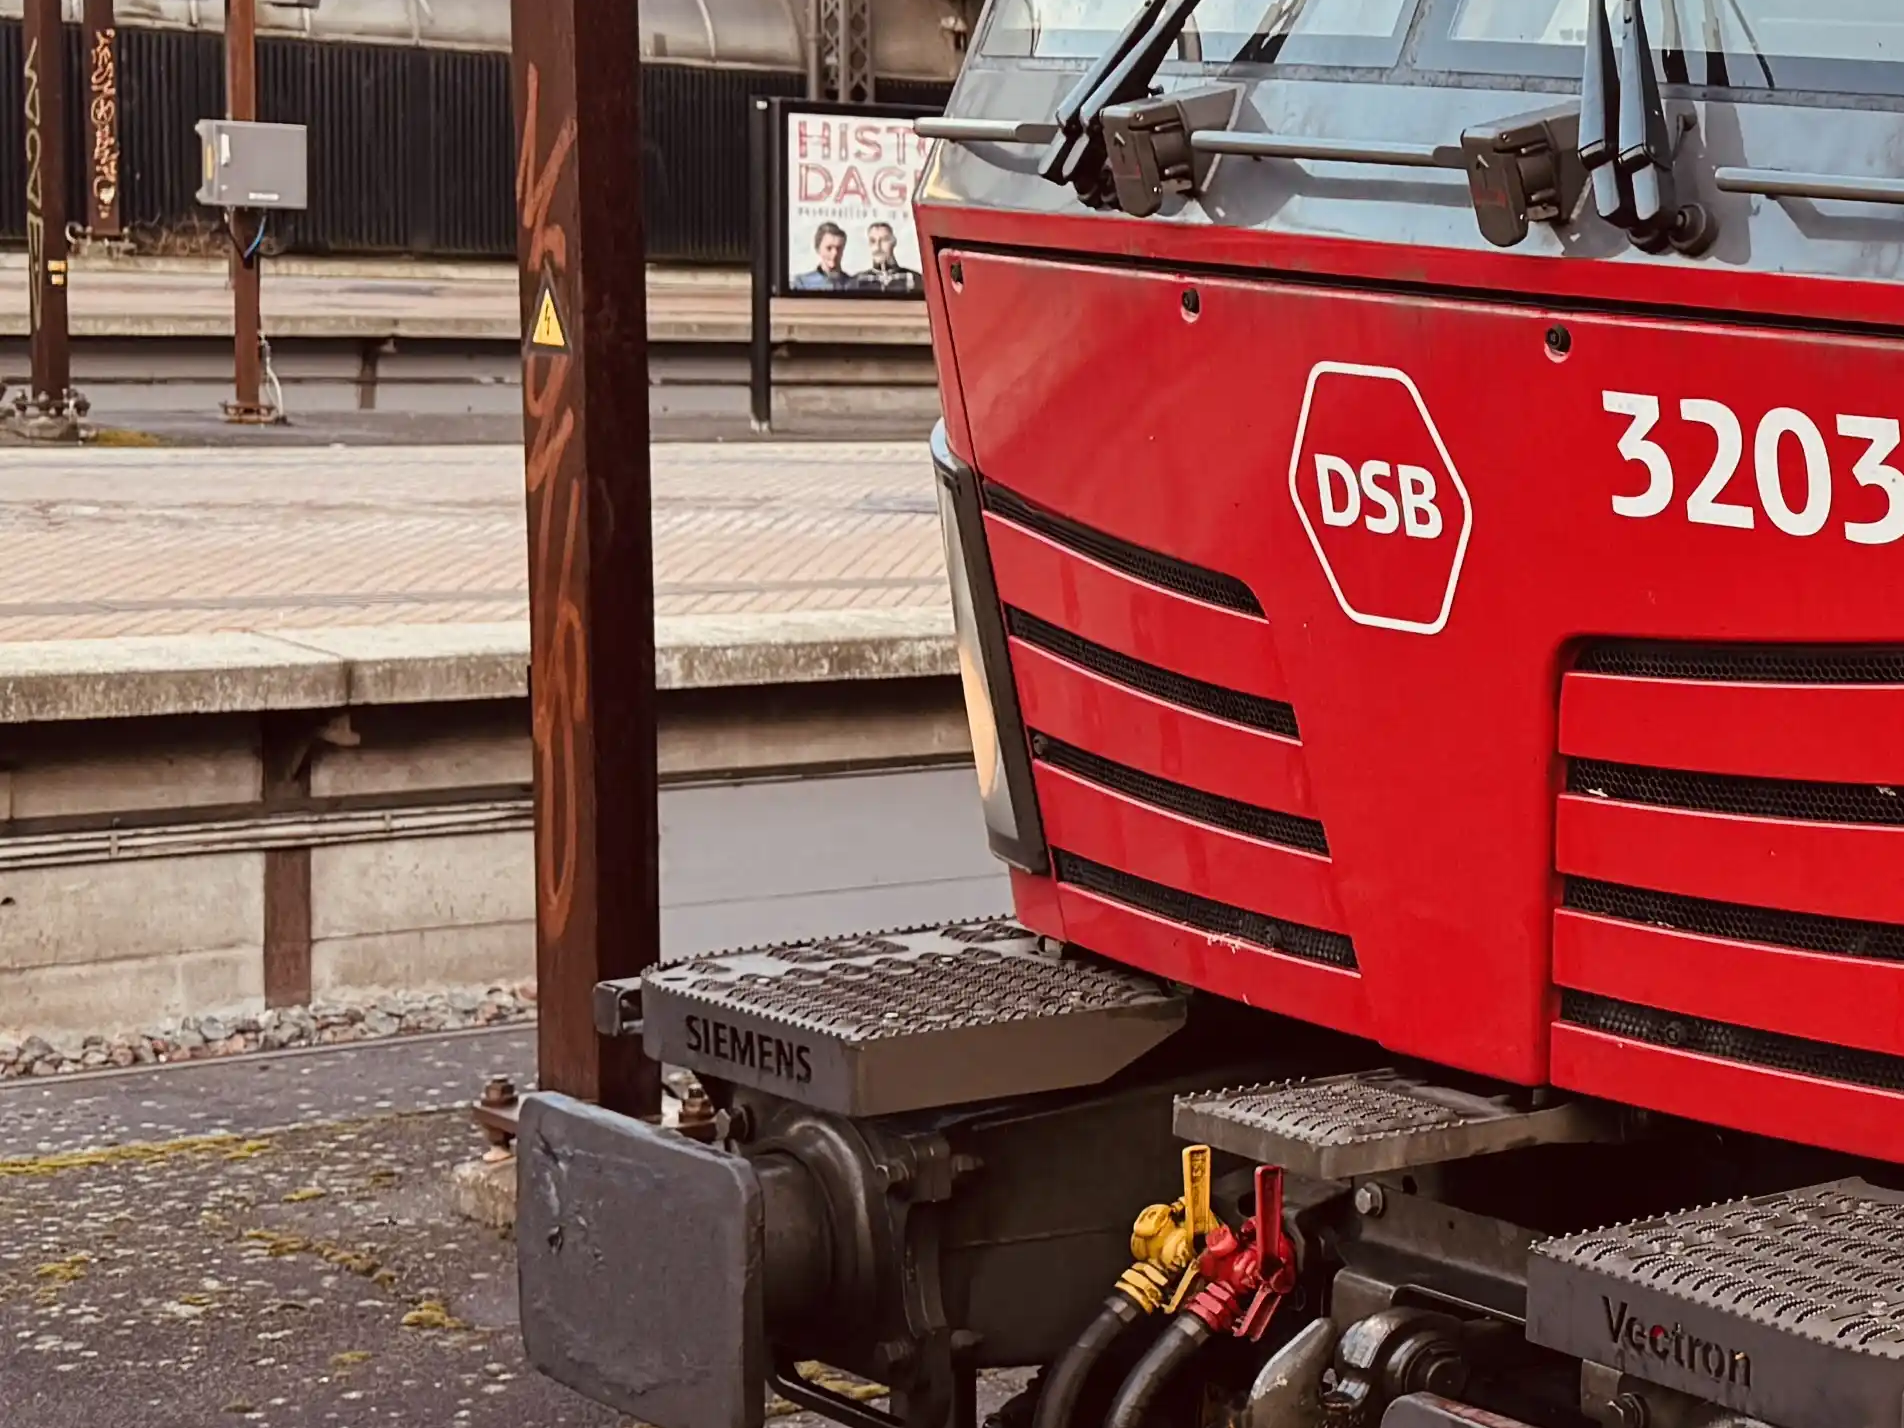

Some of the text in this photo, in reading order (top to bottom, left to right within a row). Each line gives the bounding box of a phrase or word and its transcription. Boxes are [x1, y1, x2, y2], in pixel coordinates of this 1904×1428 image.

[798, 163, 924, 207] DAG
[1313, 452, 1444, 540] DSB
[686, 1013, 813, 1085] SIEMENS
[1600, 1294, 1752, 1388] Vectron
